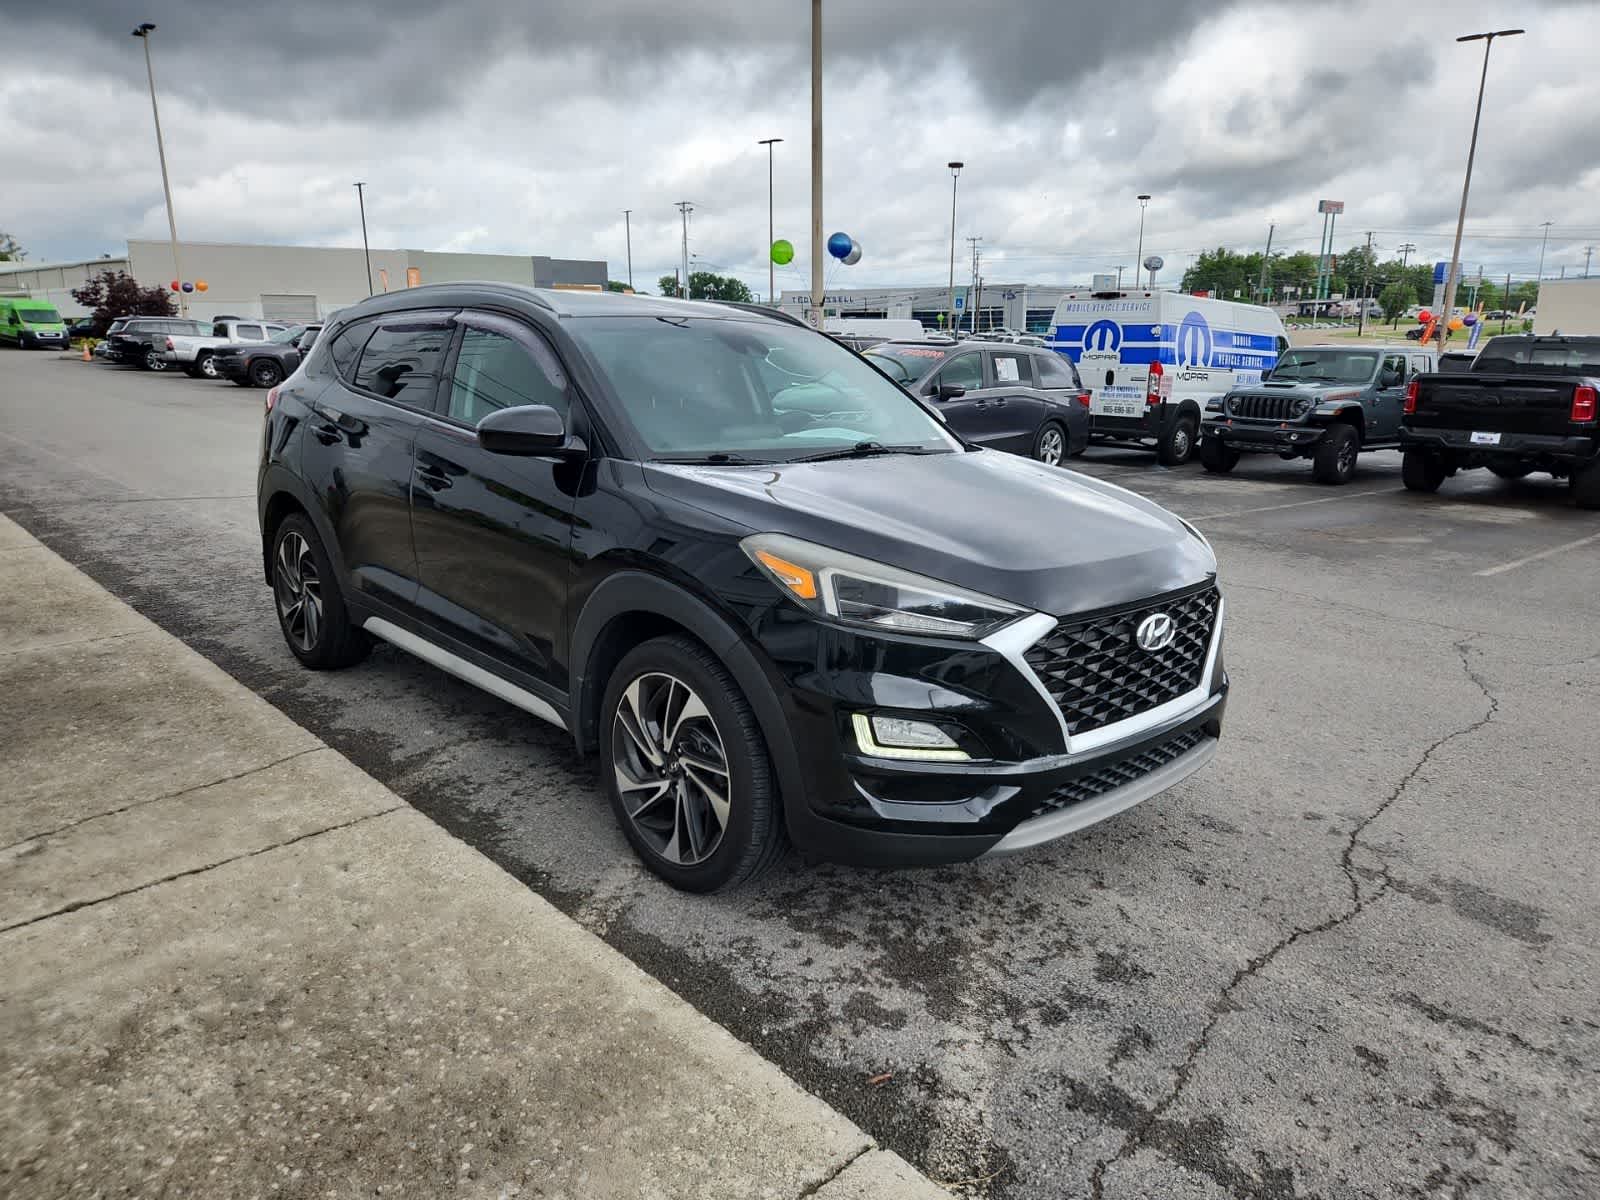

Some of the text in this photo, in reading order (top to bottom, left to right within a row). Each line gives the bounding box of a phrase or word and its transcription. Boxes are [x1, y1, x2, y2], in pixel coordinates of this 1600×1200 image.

[792, 296, 809, 304] TED
[1067, 302, 1152, 312] MOBILE VEHICLE SERVICE
[1233, 336, 1252, 346] MOBILE
[1219, 354, 1263, 367] VEHICLE SERVICE
[1176, 372, 1208, 381] MOPAR
